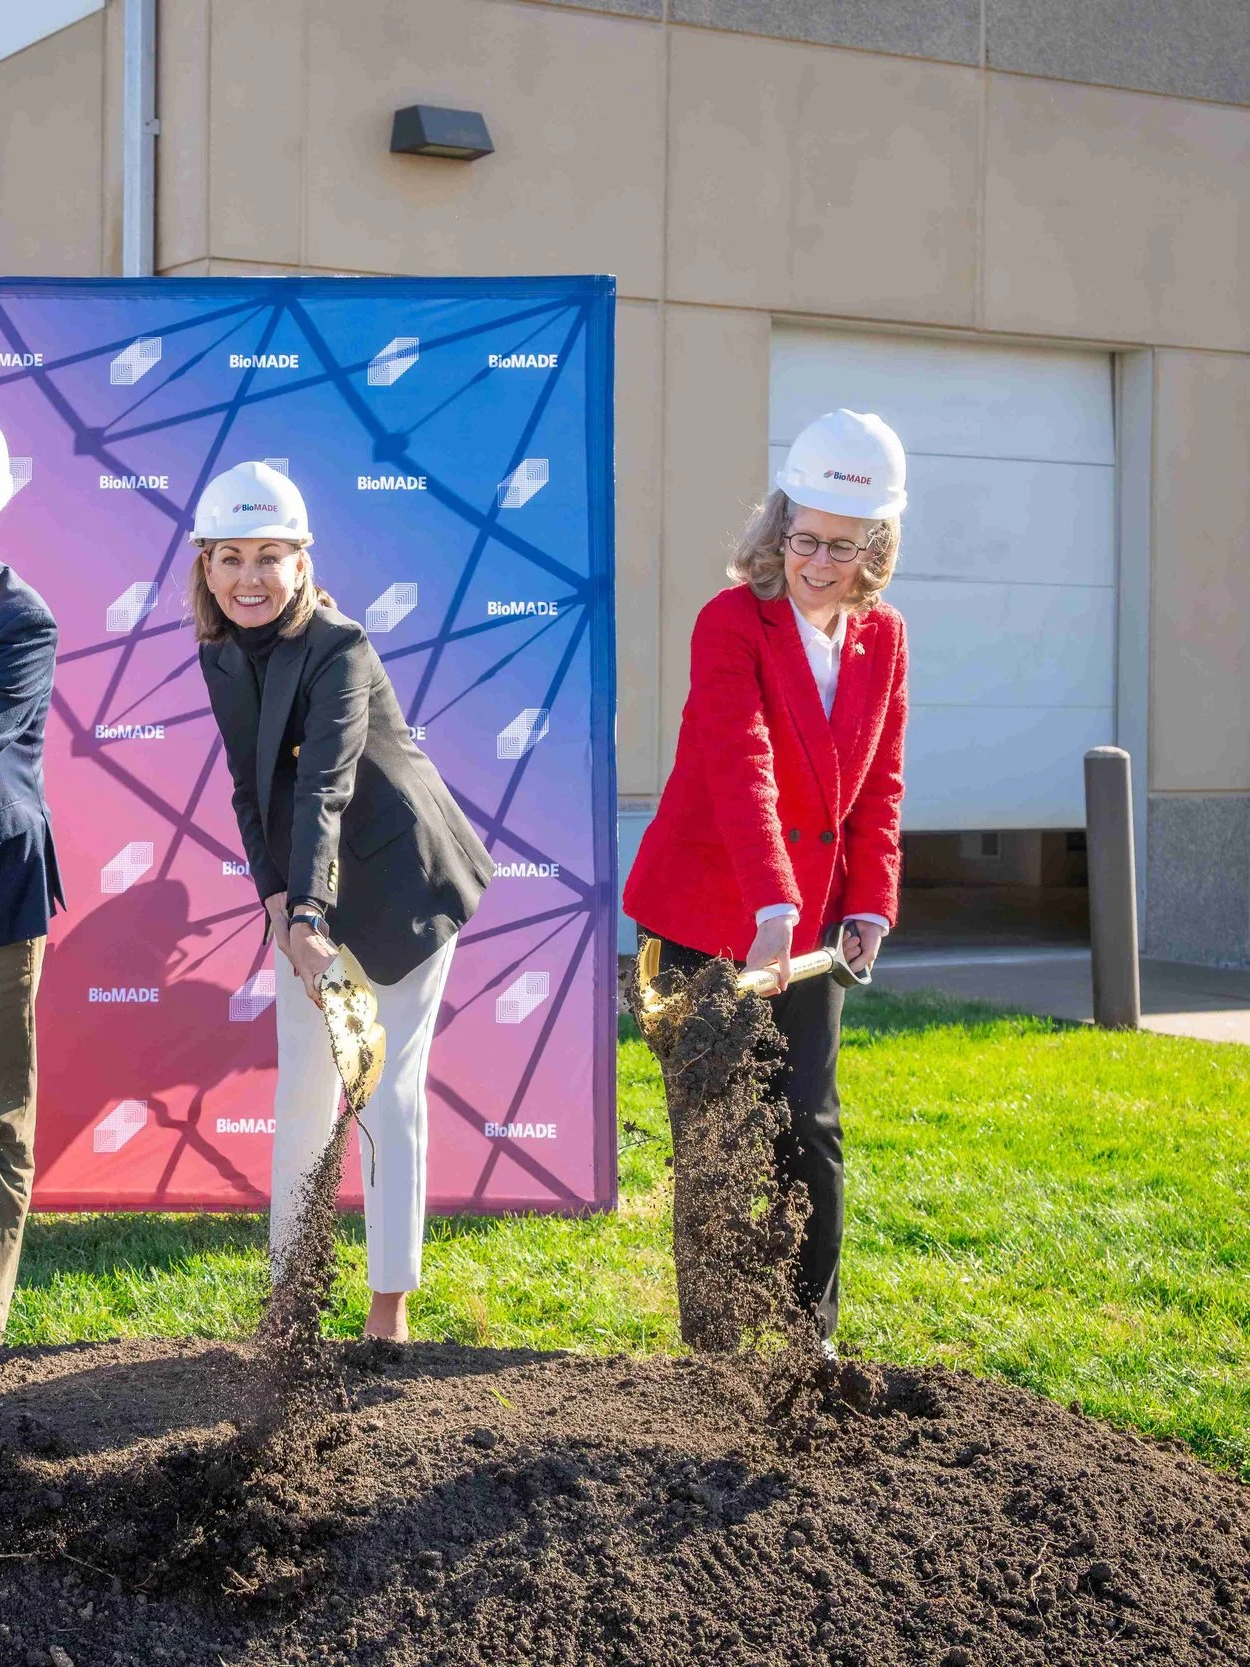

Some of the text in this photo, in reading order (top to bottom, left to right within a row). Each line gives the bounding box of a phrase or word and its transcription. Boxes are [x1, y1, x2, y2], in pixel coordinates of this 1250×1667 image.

[229, 354, 299, 368] BioMADE
[488, 354, 558, 369] BioMADE
[99, 475, 169, 489] BioMADE
[357, 476, 427, 491] BioMADE
[833, 471, 872, 485] BioMADE
[242, 504, 278, 512] BioMADE
[487, 601, 558, 615] BioMADE
[95, 724, 165, 739] BioMADE
[88, 987, 160, 1003] BioMADE
[216, 1118, 276, 1134] BioMAD
[485, 1122, 557, 1138] BioMADE
